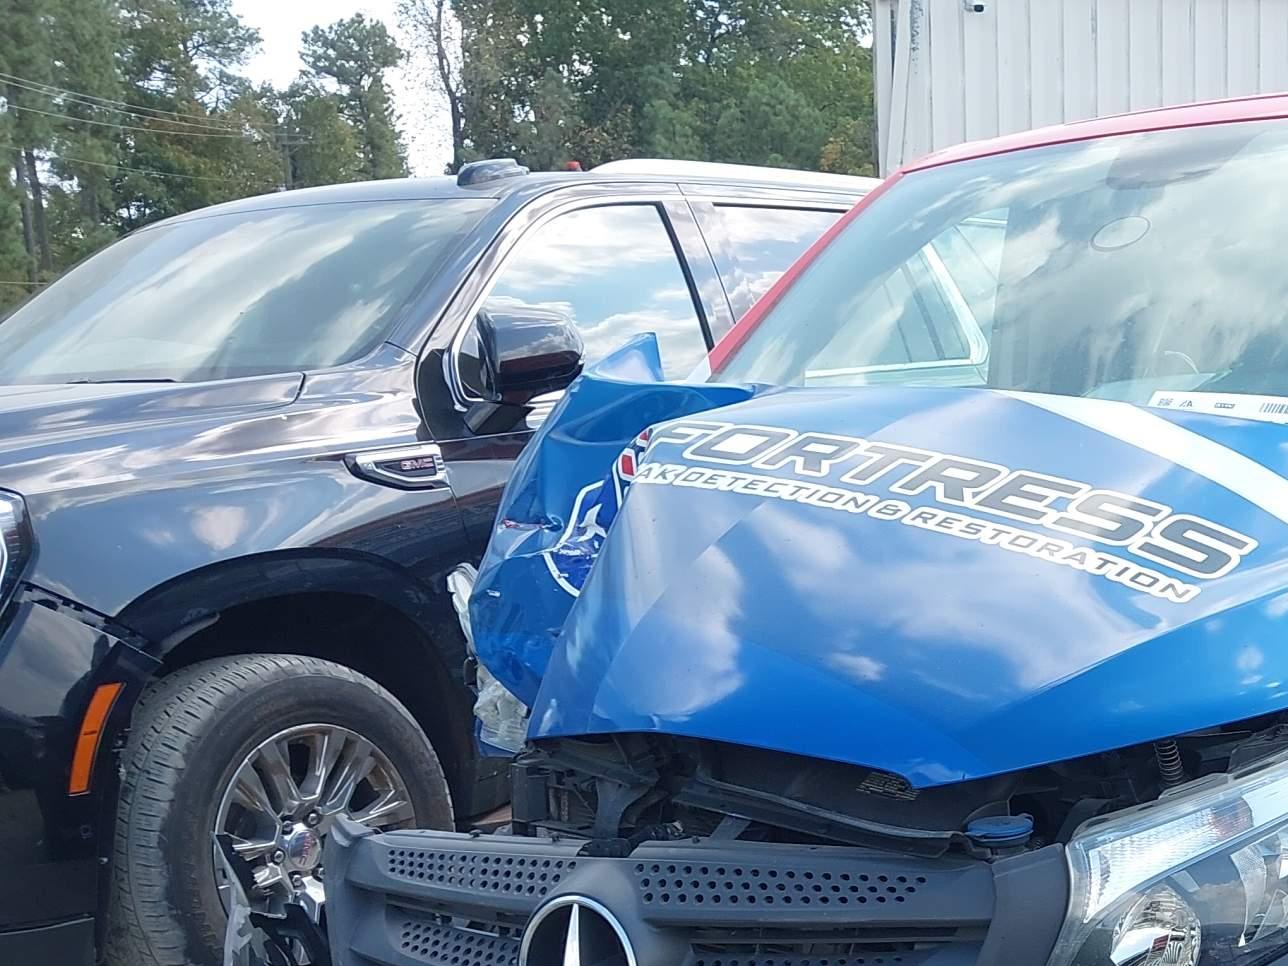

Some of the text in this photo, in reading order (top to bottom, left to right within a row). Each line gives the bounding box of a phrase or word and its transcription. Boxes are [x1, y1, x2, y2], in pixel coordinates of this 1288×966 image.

[652, 421, 1255, 579] FORTRESS
[683, 466, 885, 515] DETECTION
[909, 510, 1194, 601] RESTORATION
